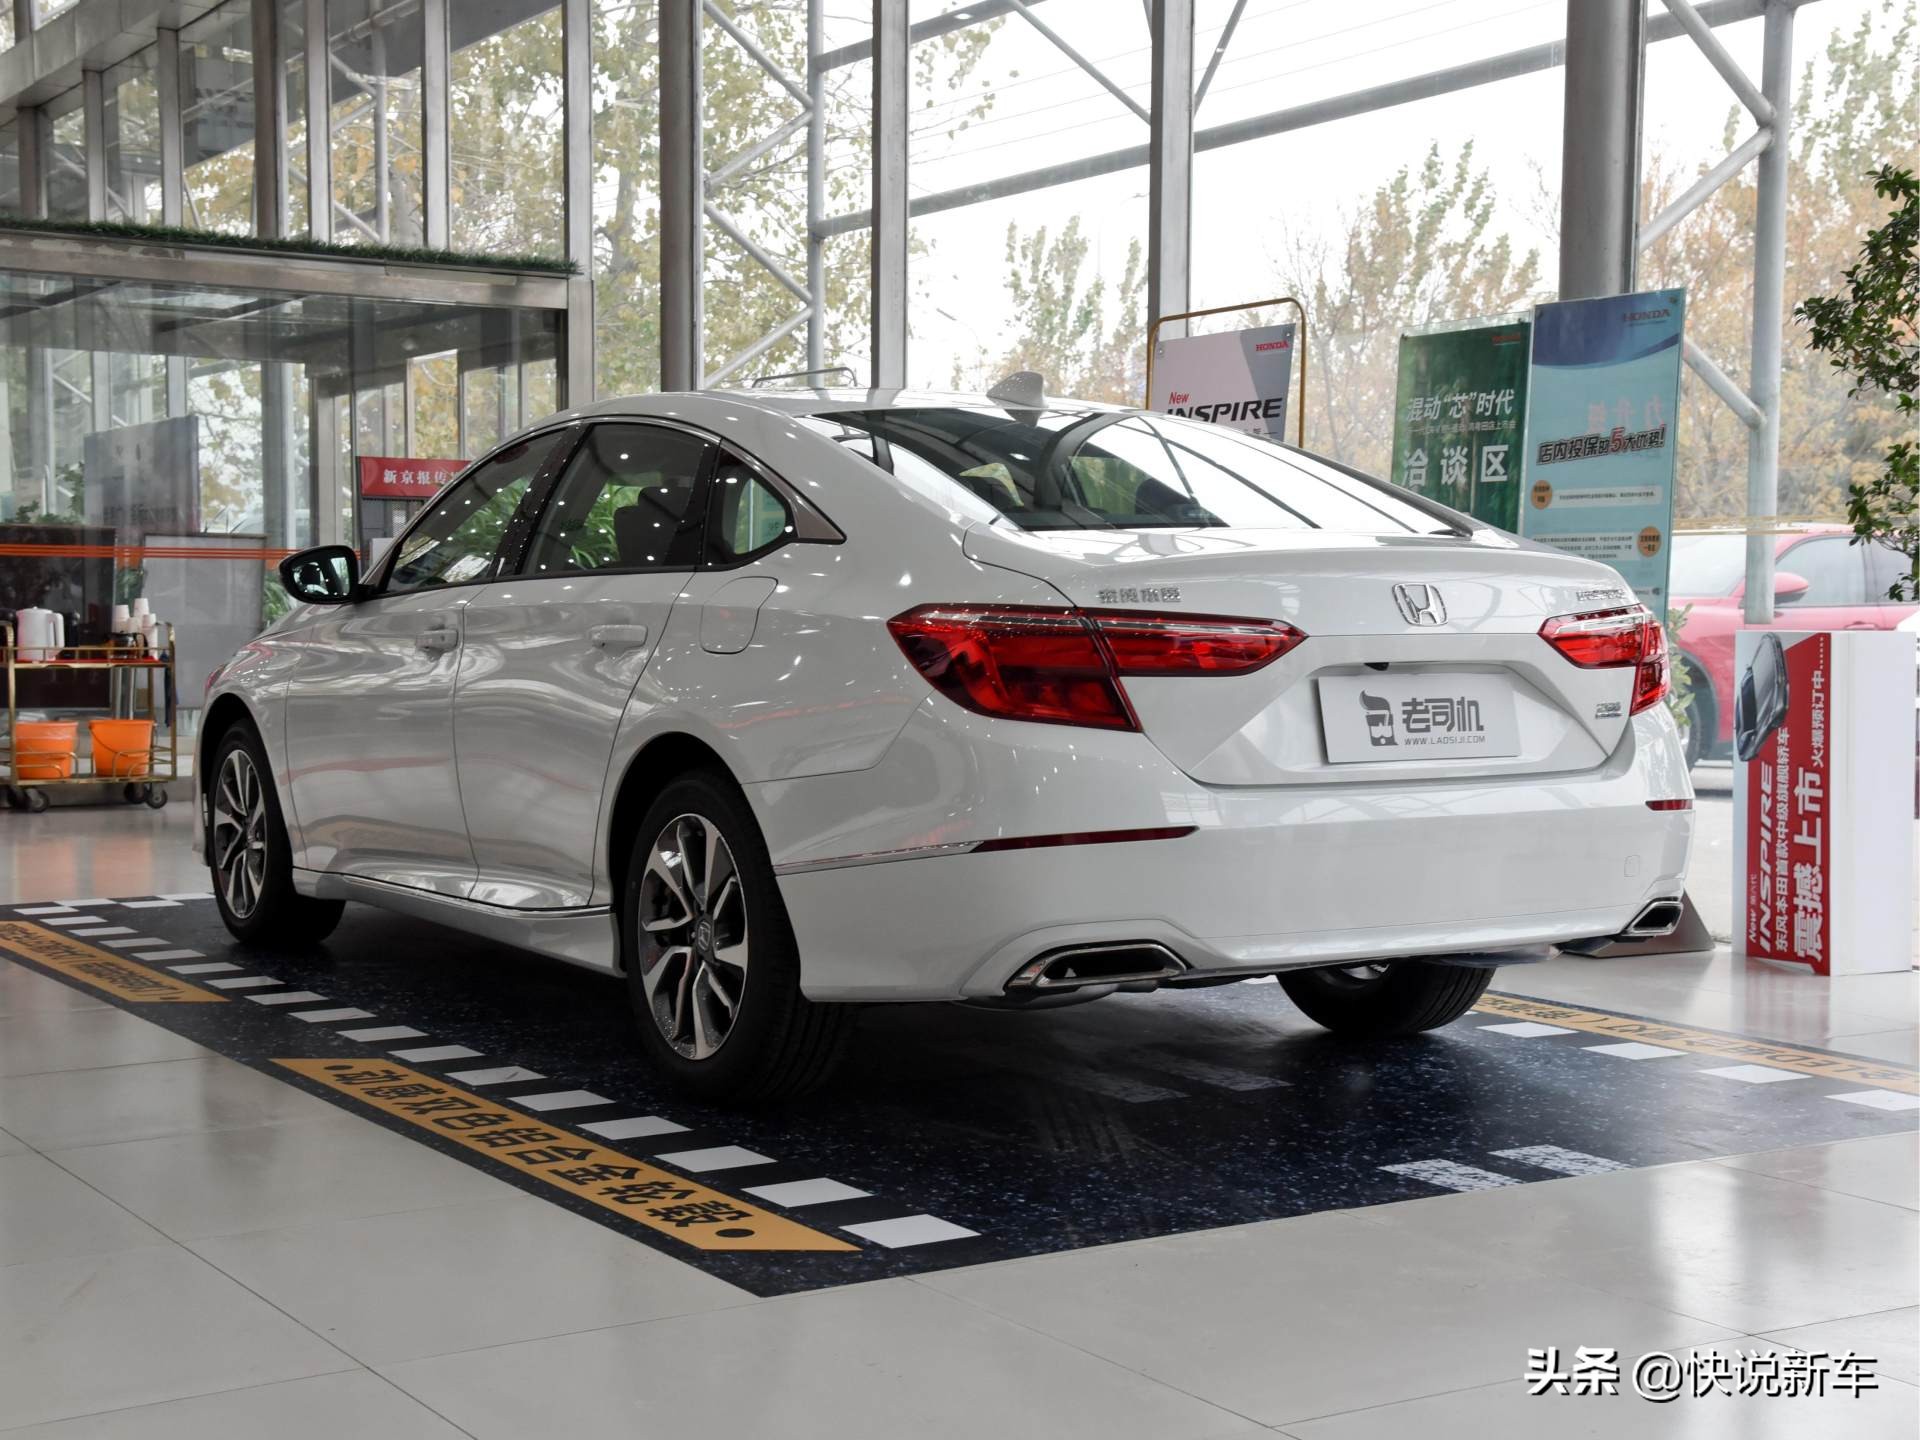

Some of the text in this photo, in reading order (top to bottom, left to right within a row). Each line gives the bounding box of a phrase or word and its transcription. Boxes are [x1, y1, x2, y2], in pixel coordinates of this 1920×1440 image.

[1624, 309, 1670, 321] HONDA
[1255, 340, 1289, 351] HONDA
[1167, 398, 1283, 424] NSPIRE
[1168, 391, 1190, 404] New
[383, 468, 460, 486] 新京报传
[1402, 444, 1509, 488] 洽谈区
[1402, 697, 1485, 733] 老司机
[1404, 735, 1486, 746] WWW.LAOSIJI.COM
[1759, 761, 1773, 953] INSPIRE
[1775, 727, 1790, 953] 东风本田首款中级旗舰轿车
[1793, 766, 1824, 962] 震撼上市
[1748, 908, 1758, 944] New
[330, 1067, 754, 1229] 动感双色铝合金轮毂
